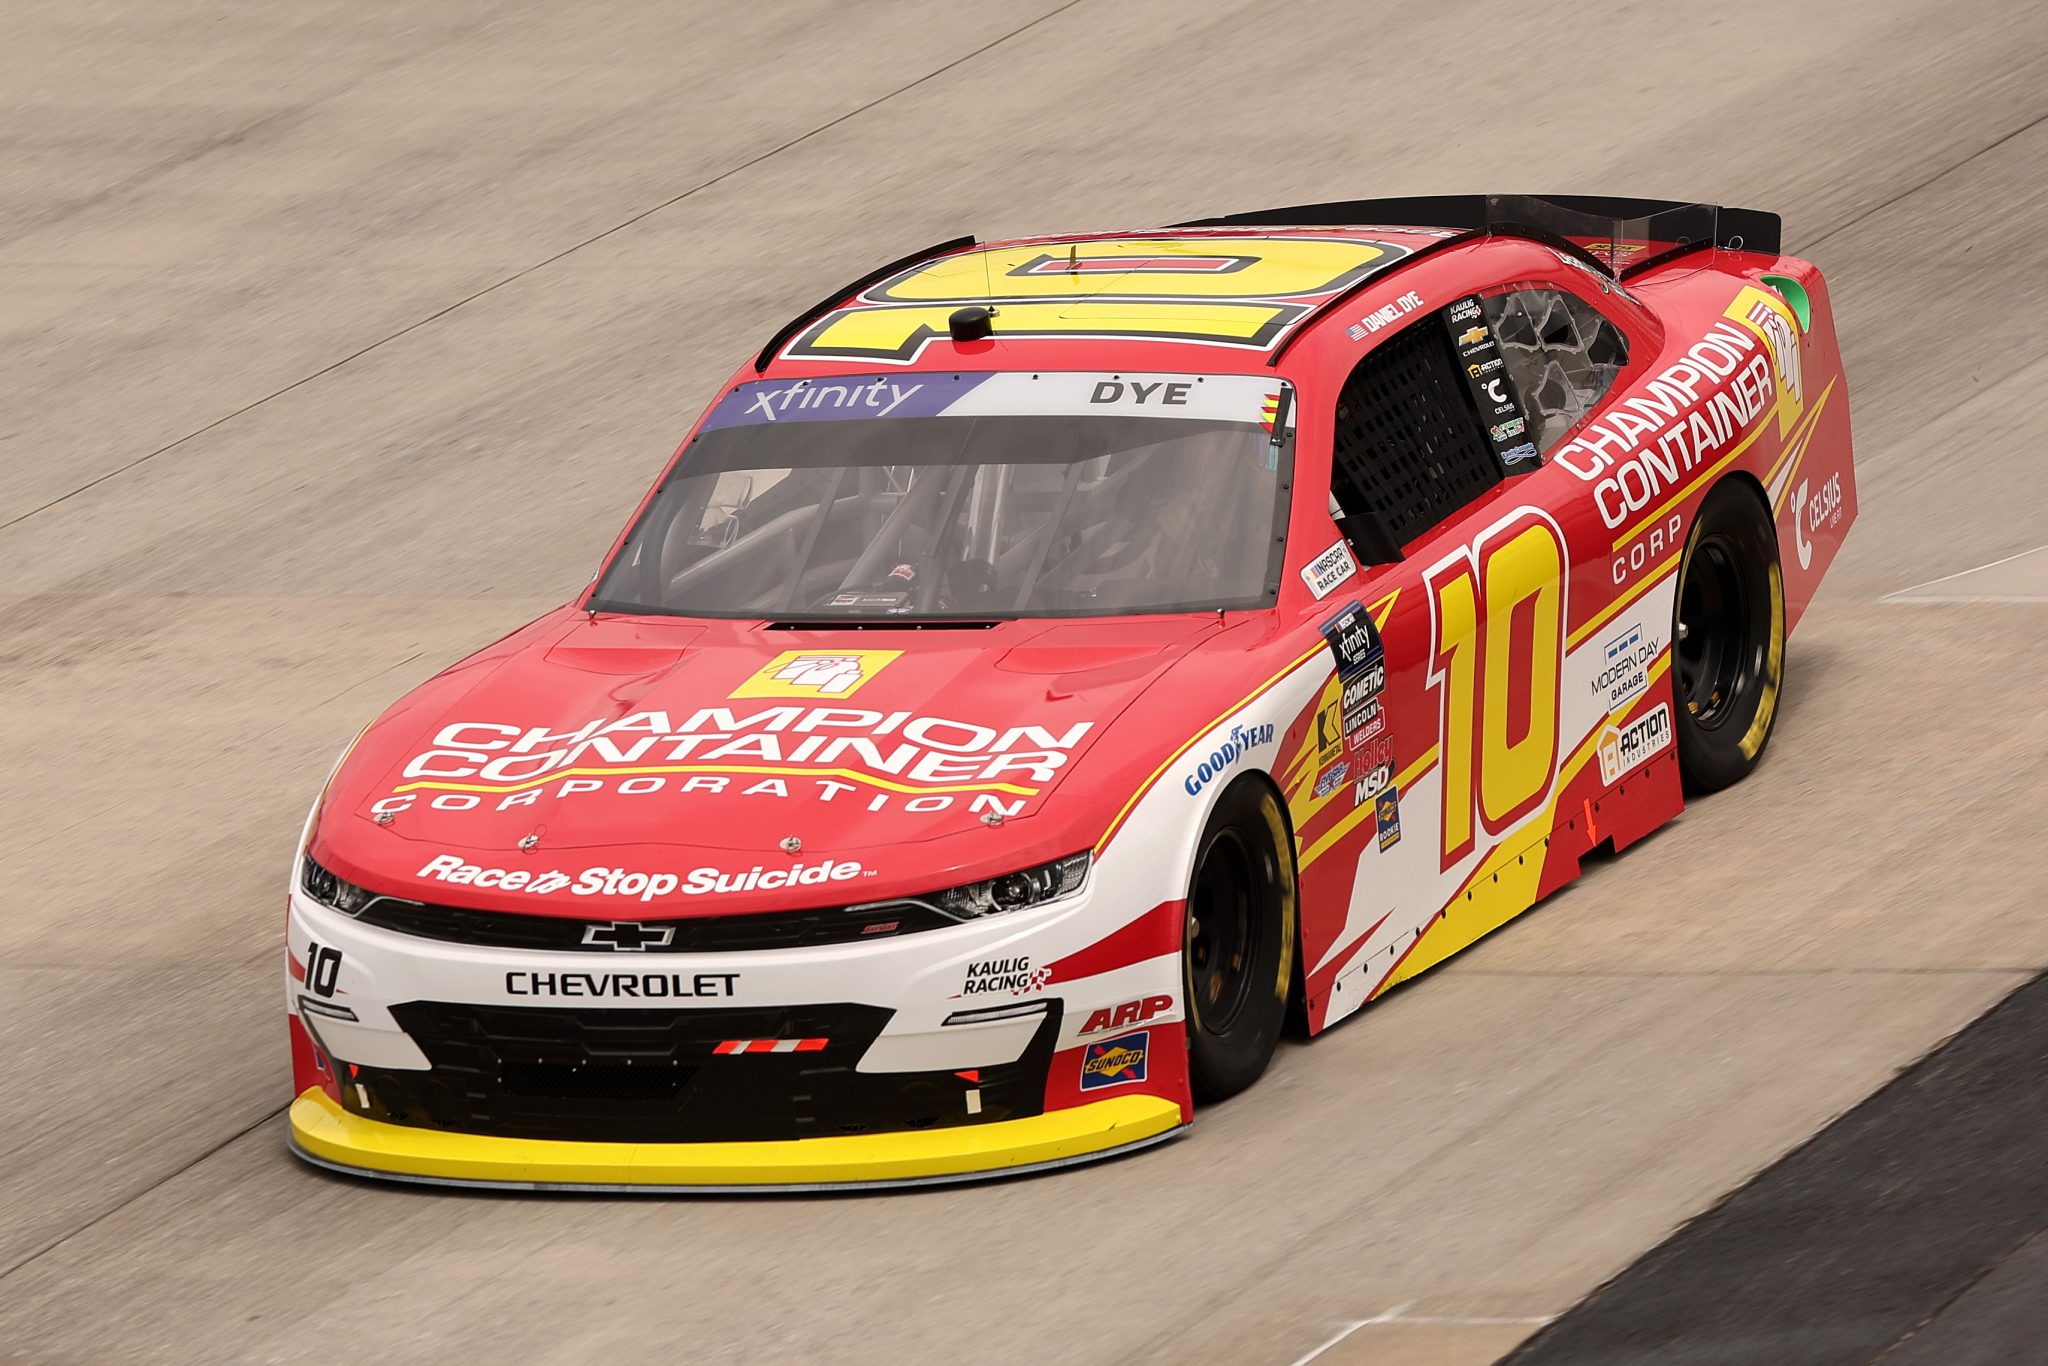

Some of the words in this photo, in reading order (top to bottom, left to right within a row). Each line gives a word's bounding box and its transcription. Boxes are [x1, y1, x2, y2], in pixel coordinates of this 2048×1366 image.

[1361, 304, 1403, 333] DANIEL
[1399, 290, 1424, 316] DYE
[1450, 299, 1475, 315] KAULIG
[1451, 308, 1477, 324] RACING
[744, 378, 926, 421] xfinity
[1089, 381, 1193, 406] DYE
[1553, 322, 1755, 481] CHAMPION
[1593, 353, 1774, 529] CONTAINER
[1809, 471, 1841, 533] CELSIUS
[1318, 547, 1346, 573] NASCAR
[1612, 514, 1682, 585] CORP
[1317, 571, 1338, 591] RACE
[1335, 561, 1351, 577] CAR
[1338, 624, 1370, 662] xfinity
[1343, 666, 1384, 709] COMETIC
[1591, 651, 1637, 696] MODERN
[1639, 637, 1660, 665] DAY
[1611, 672, 1644, 701] GARAGE
[1421, 505, 1571, 875] 10
[430, 706, 1095, 756] CHAMPION
[1345, 702, 1377, 734] LINCOLN
[1353, 718, 1382, 745] WELDERS
[1620, 708, 1668, 757] ACTION
[401, 732, 1069, 783] CONTAINER
[1184, 723, 1274, 797] GOODYEAR
[1354, 733, 1394, 784] Holley
[1623, 730, 1670, 768] INDUSTRIES
[370, 775, 1026, 817] CORPORATION
[1354, 766, 1389, 807] MSD
[1380, 822, 1400, 842] ROOKIE
[416, 853, 527, 890] Race
[522, 868, 572, 895] to
[570, 866, 679, 902] Stop
[681, 859, 862, 895] Suicide
[304, 942, 343, 999] 10
[505, 971, 741, 998] CHEVROLET
[963, 974, 1029, 995] RACING
[966, 956, 1030, 978] KAULIG
[1078, 995, 1174, 1034] ARP
[1084, 1049, 1144, 1073] SUNOCO
